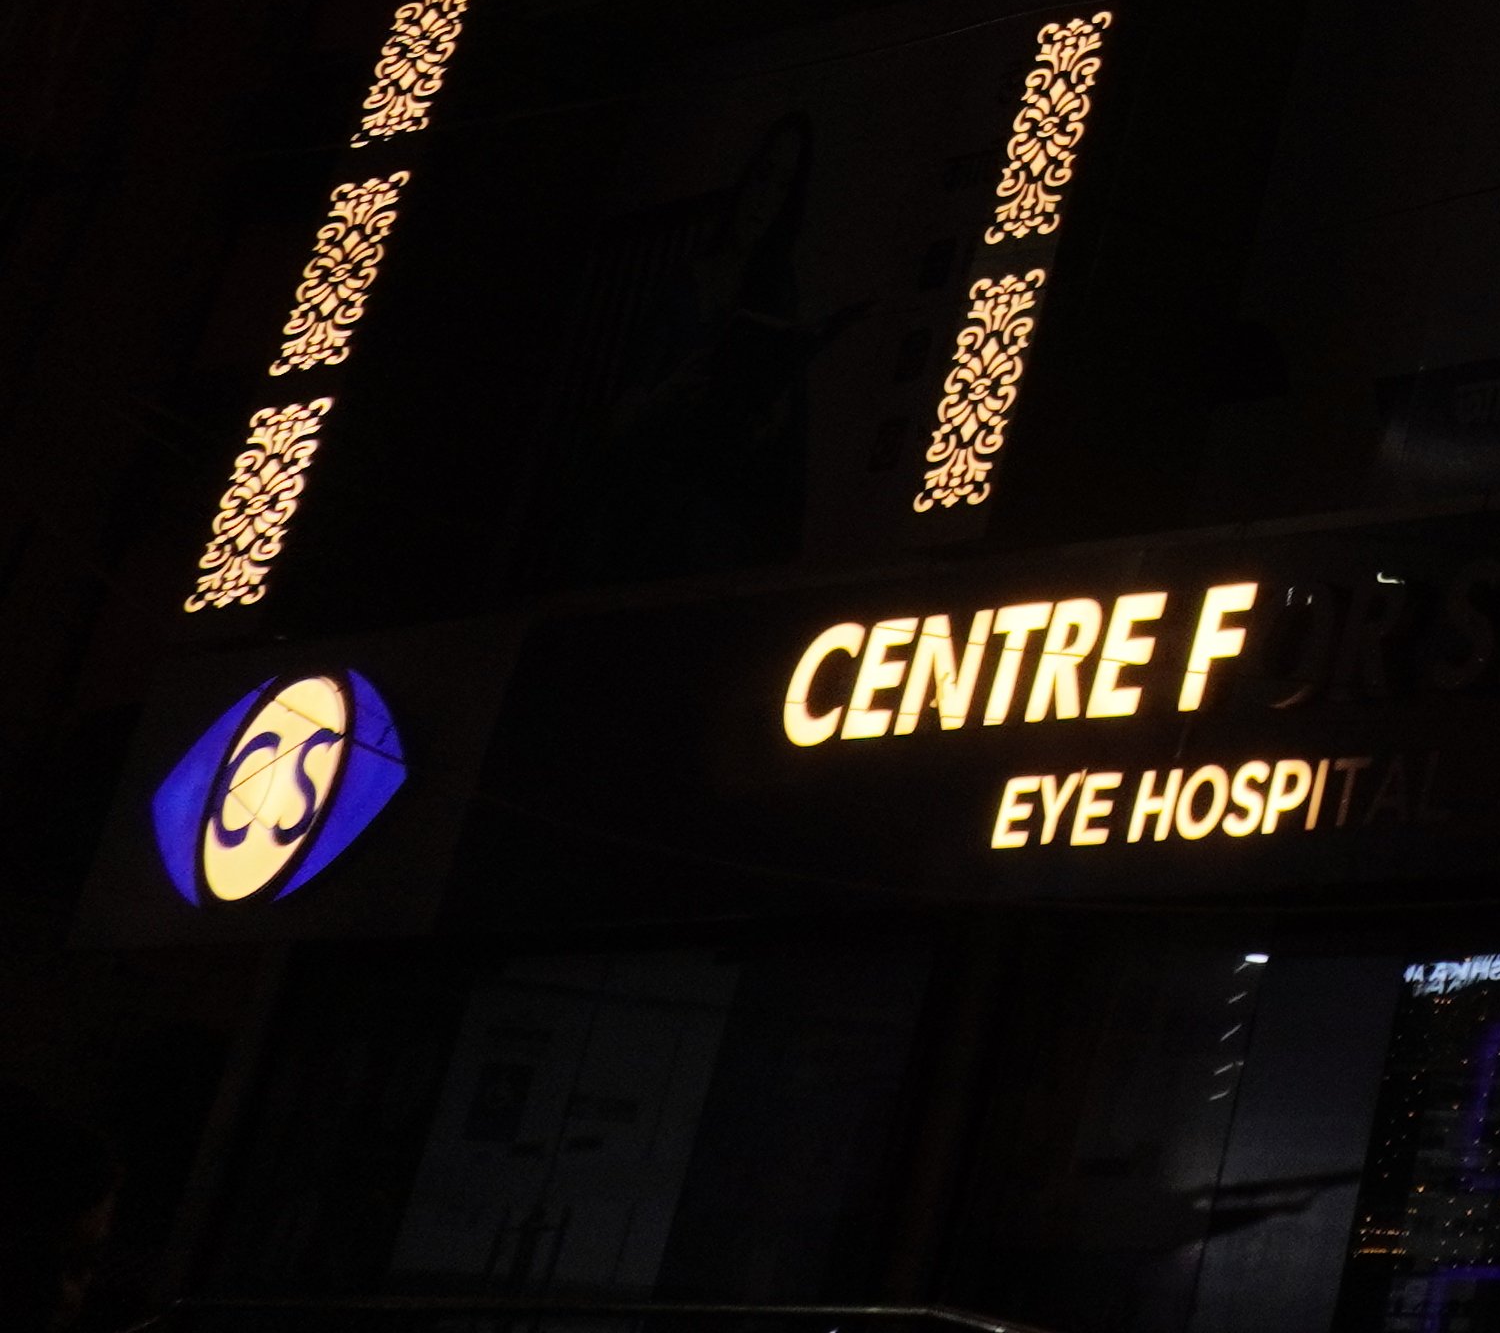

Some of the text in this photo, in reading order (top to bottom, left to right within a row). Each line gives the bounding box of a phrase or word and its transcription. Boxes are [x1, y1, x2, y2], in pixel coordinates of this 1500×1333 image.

[784, 583, 1168, 746] CENTRE
[991, 751, 1452, 849] EYE HOSPITAL
